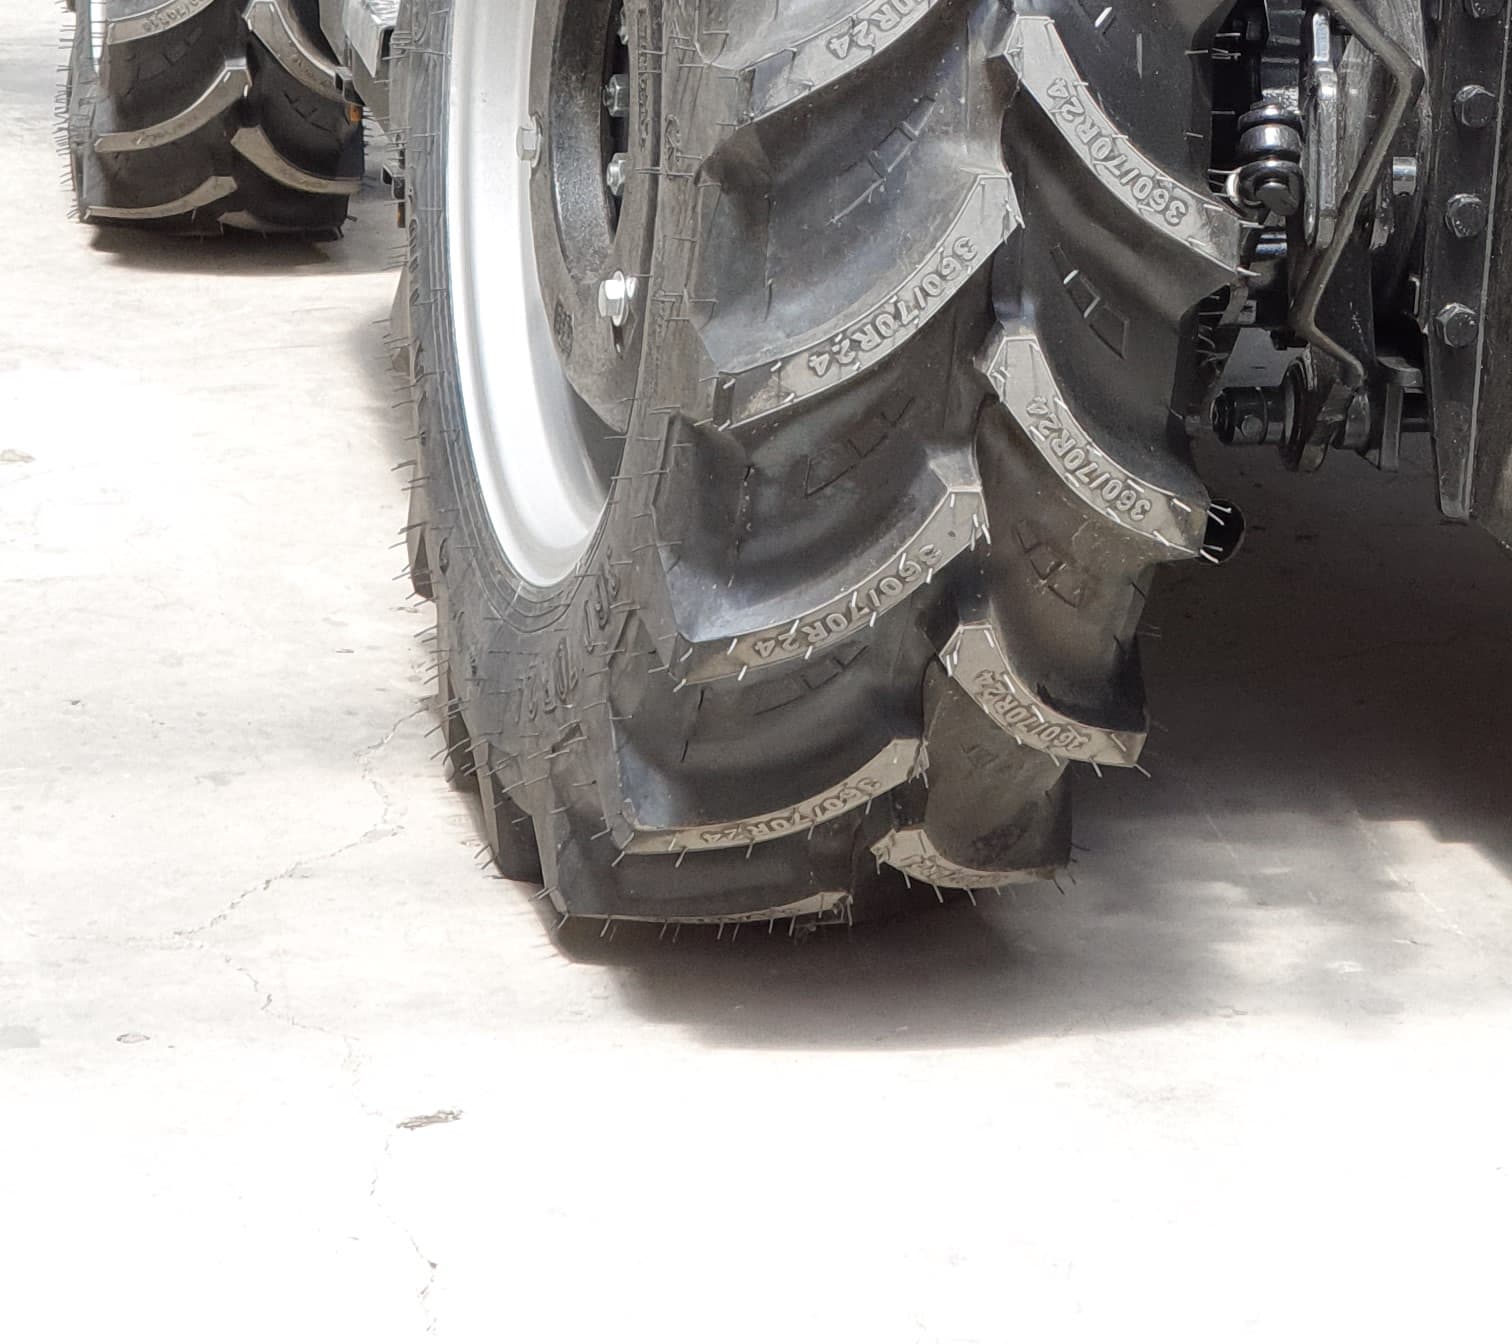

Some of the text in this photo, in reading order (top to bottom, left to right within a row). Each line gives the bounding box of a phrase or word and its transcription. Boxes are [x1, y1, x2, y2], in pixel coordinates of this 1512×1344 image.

[1045, 77, 1188, 226] 360/70R24
[807, 235, 979, 377] 360/70R24
[1026, 395, 1154, 521] 360/70R24
[753, 543, 942, 660] 360/70R24
